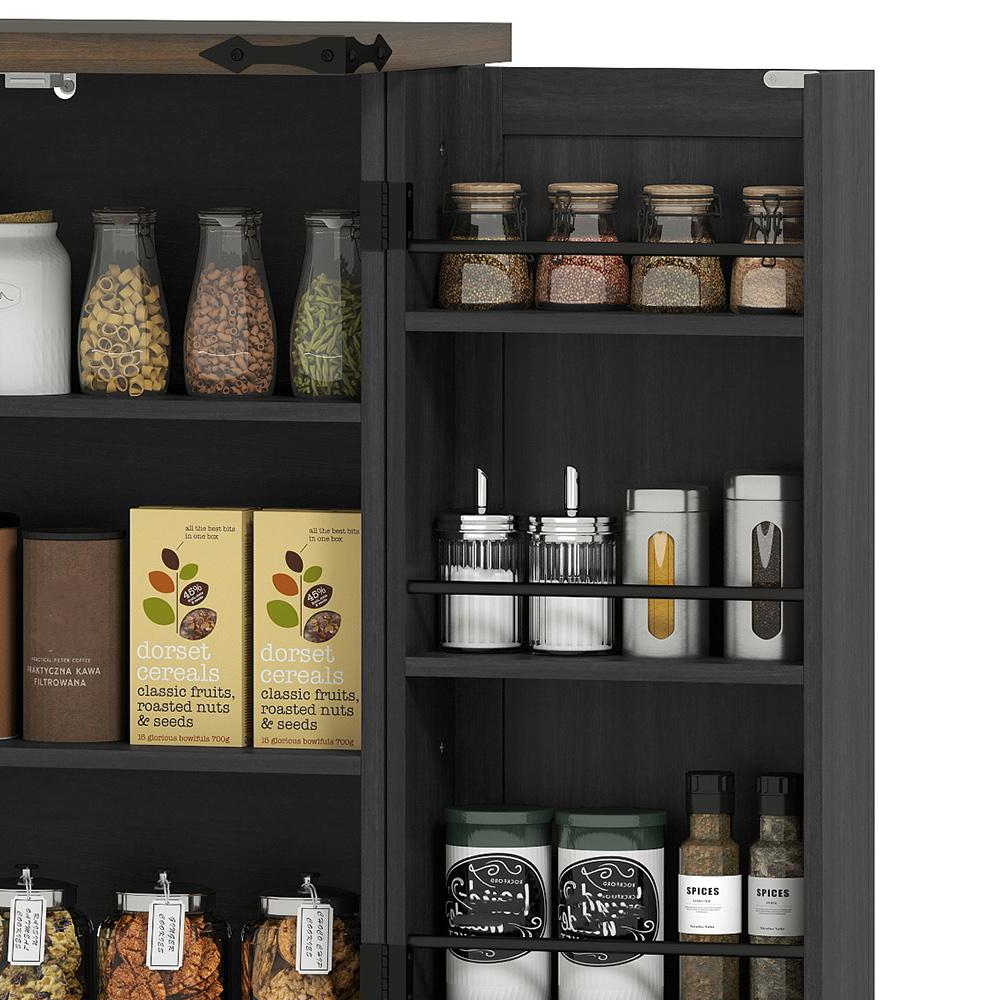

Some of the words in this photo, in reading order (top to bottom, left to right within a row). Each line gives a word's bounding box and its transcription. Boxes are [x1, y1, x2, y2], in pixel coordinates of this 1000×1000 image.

[136, 641, 211, 660] dorset
[260, 643, 335, 663] dorset
[76, 667, 101, 675] KAWA
[136, 663, 219, 682] cereals
[260, 666, 344, 685] cereals
[34, 678, 87, 687] FILTROWANA
[137, 685, 187, 697] classic
[190, 686, 235, 700] fruits,
[261, 688, 310, 700] classic
[314, 689, 359, 703] fruits,
[137, 701, 192, 712] roasted
[196, 702, 230, 713] nuts
[261, 704, 316, 716] roasted
[320, 705, 354, 717] nuts
[137, 714, 150, 727] &
[153, 716, 194, 727] seeds
[261, 718, 274, 730] &
[277, 719, 318, 731] seeds
[147, 734, 177, 742] glorious
[271, 737, 301, 745] glorious
[686, 886, 720, 896] SPICES
[756, 888, 790, 898] SPICES
[32, 913, 40, 946] RAISIN
[316, 911, 324, 941] CHOCO
[157, 914, 166, 954] COOKIES
[168, 916, 176, 952] GINGER
[316, 944, 324, 968] CHIP
